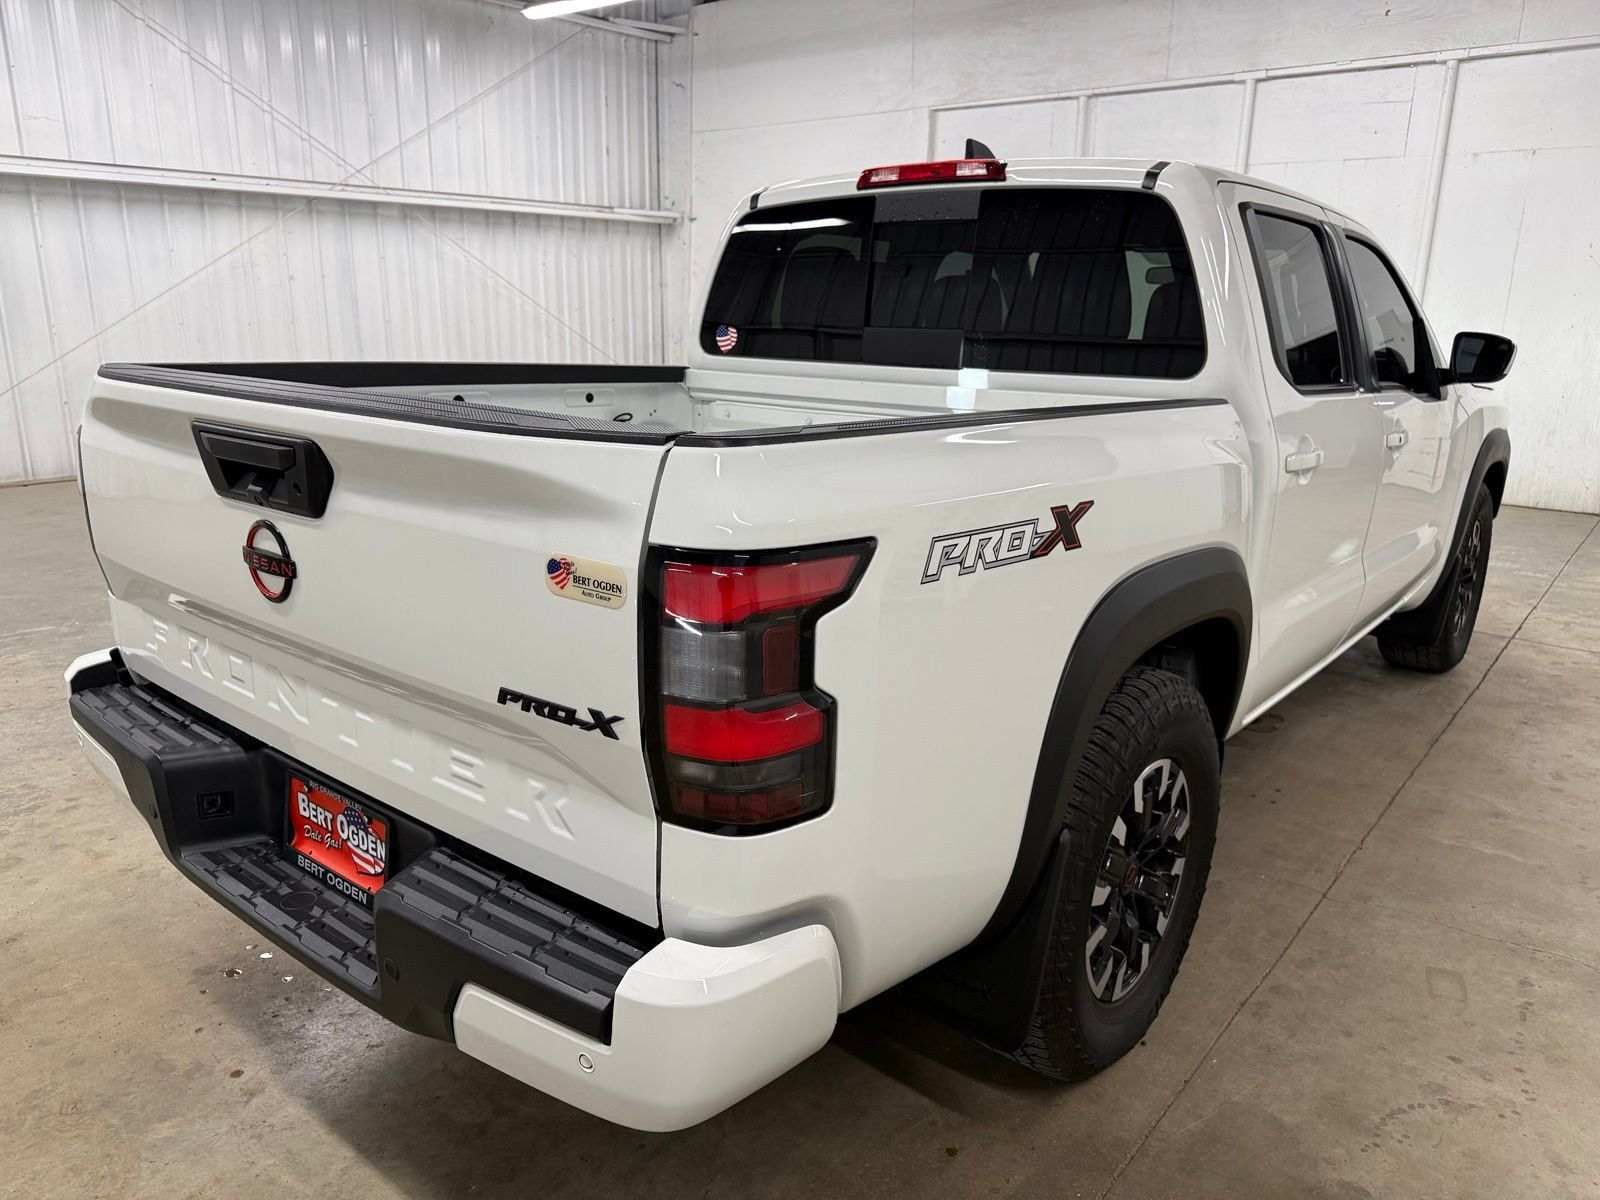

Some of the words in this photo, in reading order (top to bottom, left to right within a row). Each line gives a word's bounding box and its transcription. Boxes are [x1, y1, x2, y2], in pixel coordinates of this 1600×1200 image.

[244, 549, 293, 577] NISSAN
[920, 500, 1095, 585] PRO-X
[572, 574, 591, 587] BERT
[592, 579, 622, 594] OGDEN
[146, 616, 576, 840] FRONTIER
[497, 687, 626, 741] PRO-X
[297, 791, 333, 832] BERT
[336, 813, 386, 862] OGDEN
[303, 824, 322, 842] Dale
[324, 833, 343, 849] Gas!
[297, 854, 325, 879] BERT
[326, 872, 367, 905] OGDEN
